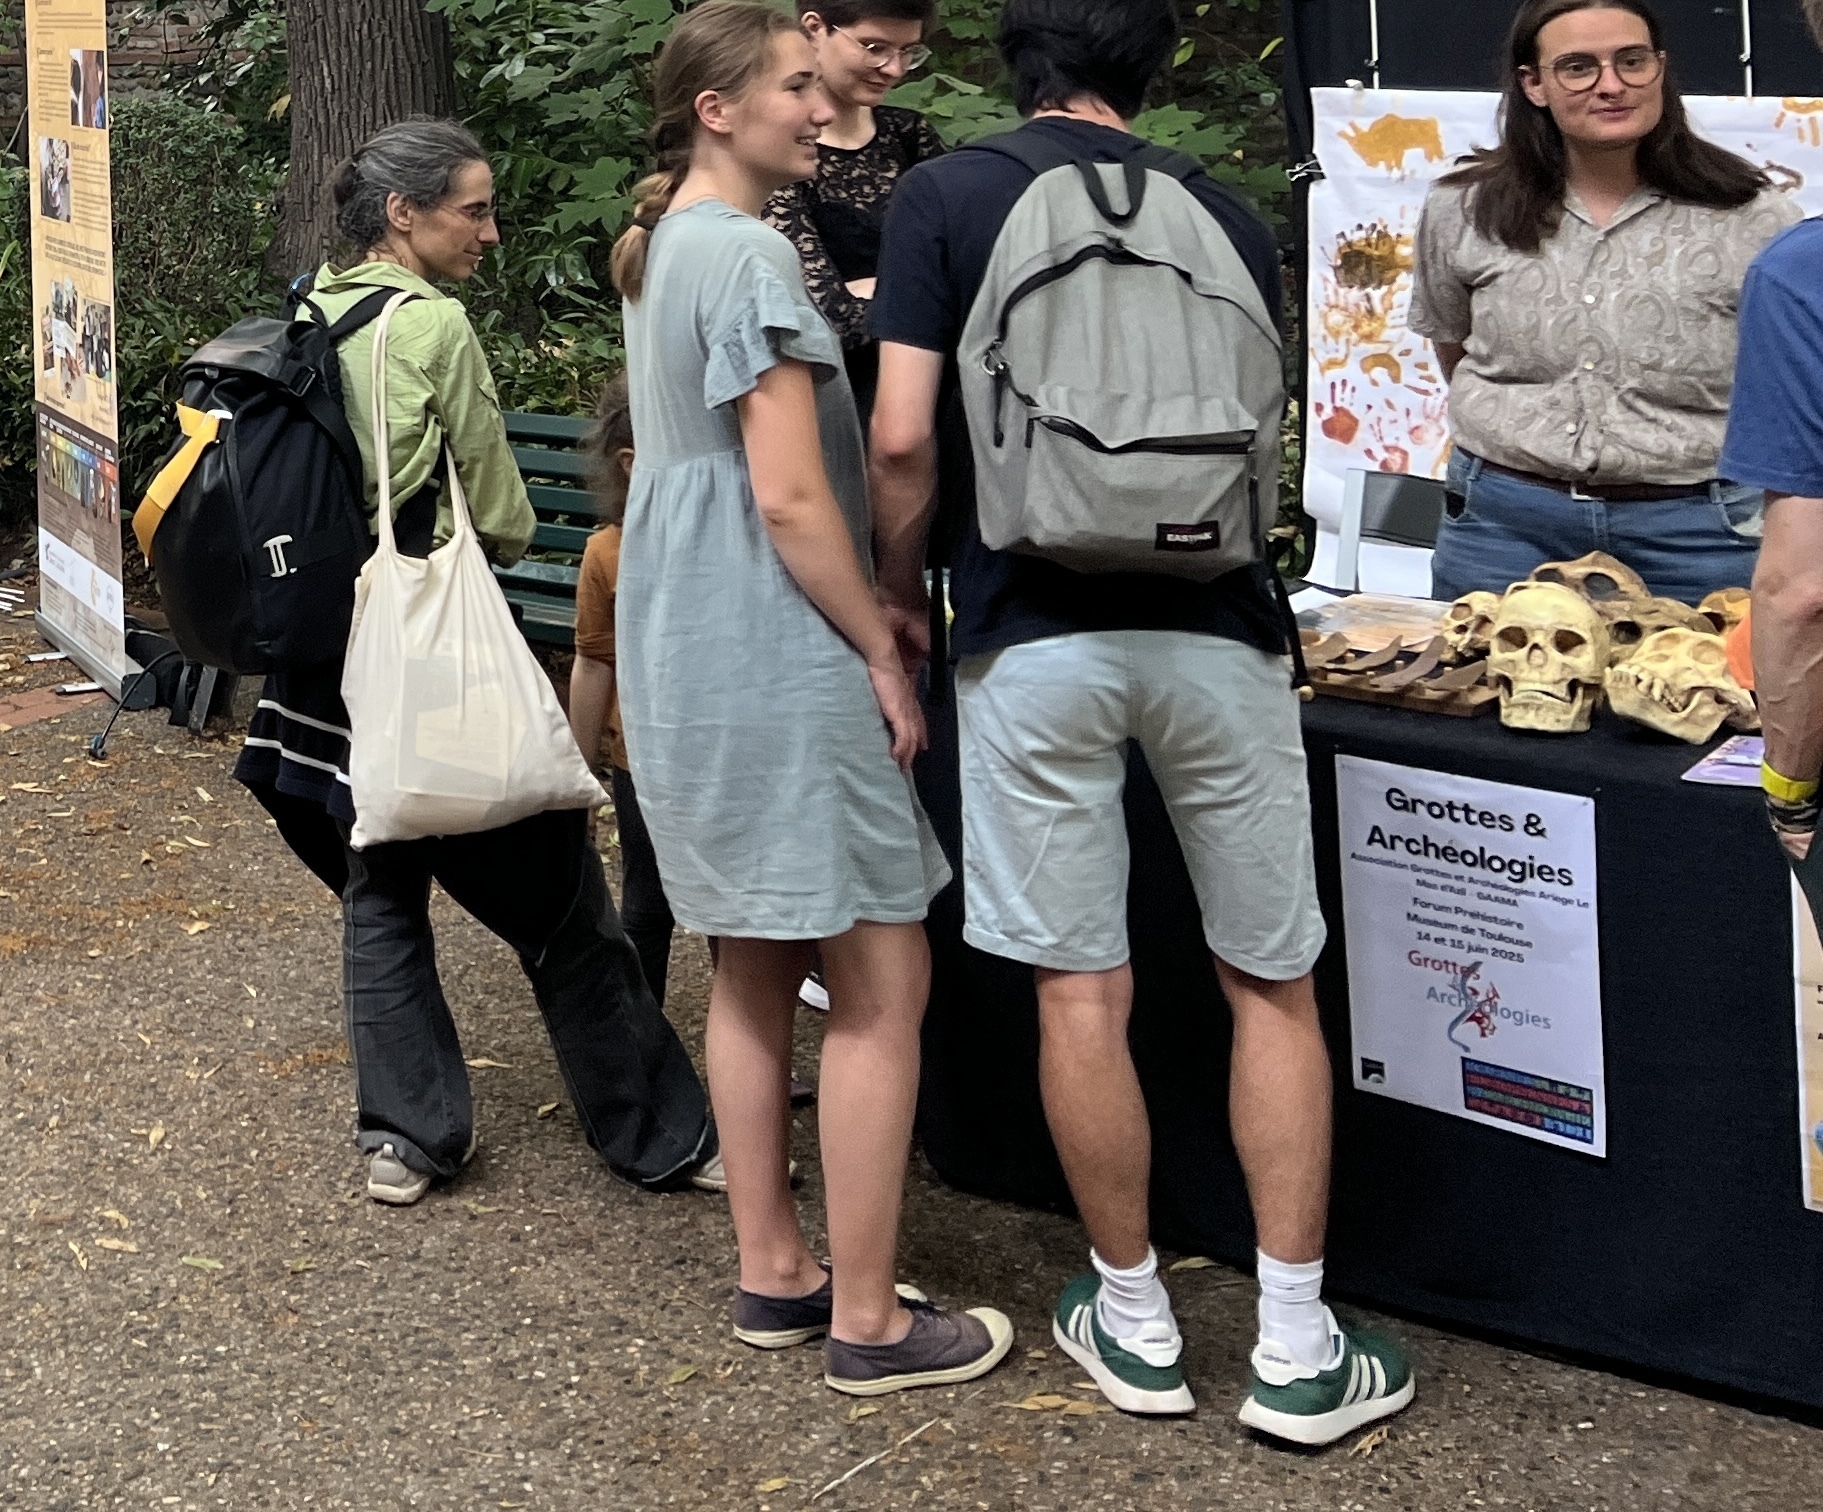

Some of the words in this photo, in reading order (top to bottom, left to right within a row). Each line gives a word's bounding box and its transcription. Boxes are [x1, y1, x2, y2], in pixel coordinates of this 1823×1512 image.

[1385, 787, 1515, 833] Grottes
[1523, 813, 1548, 838] &
[1412, 897, 1452, 913] Forum
[1477, 927, 1533, 948] Toulouse
[1407, 950, 1480, 980] Grottes
[1466, 941, 1489, 955] juin
[1491, 947, 1525, 963] 2025
[1426, 986, 1552, 1030] Archologies
